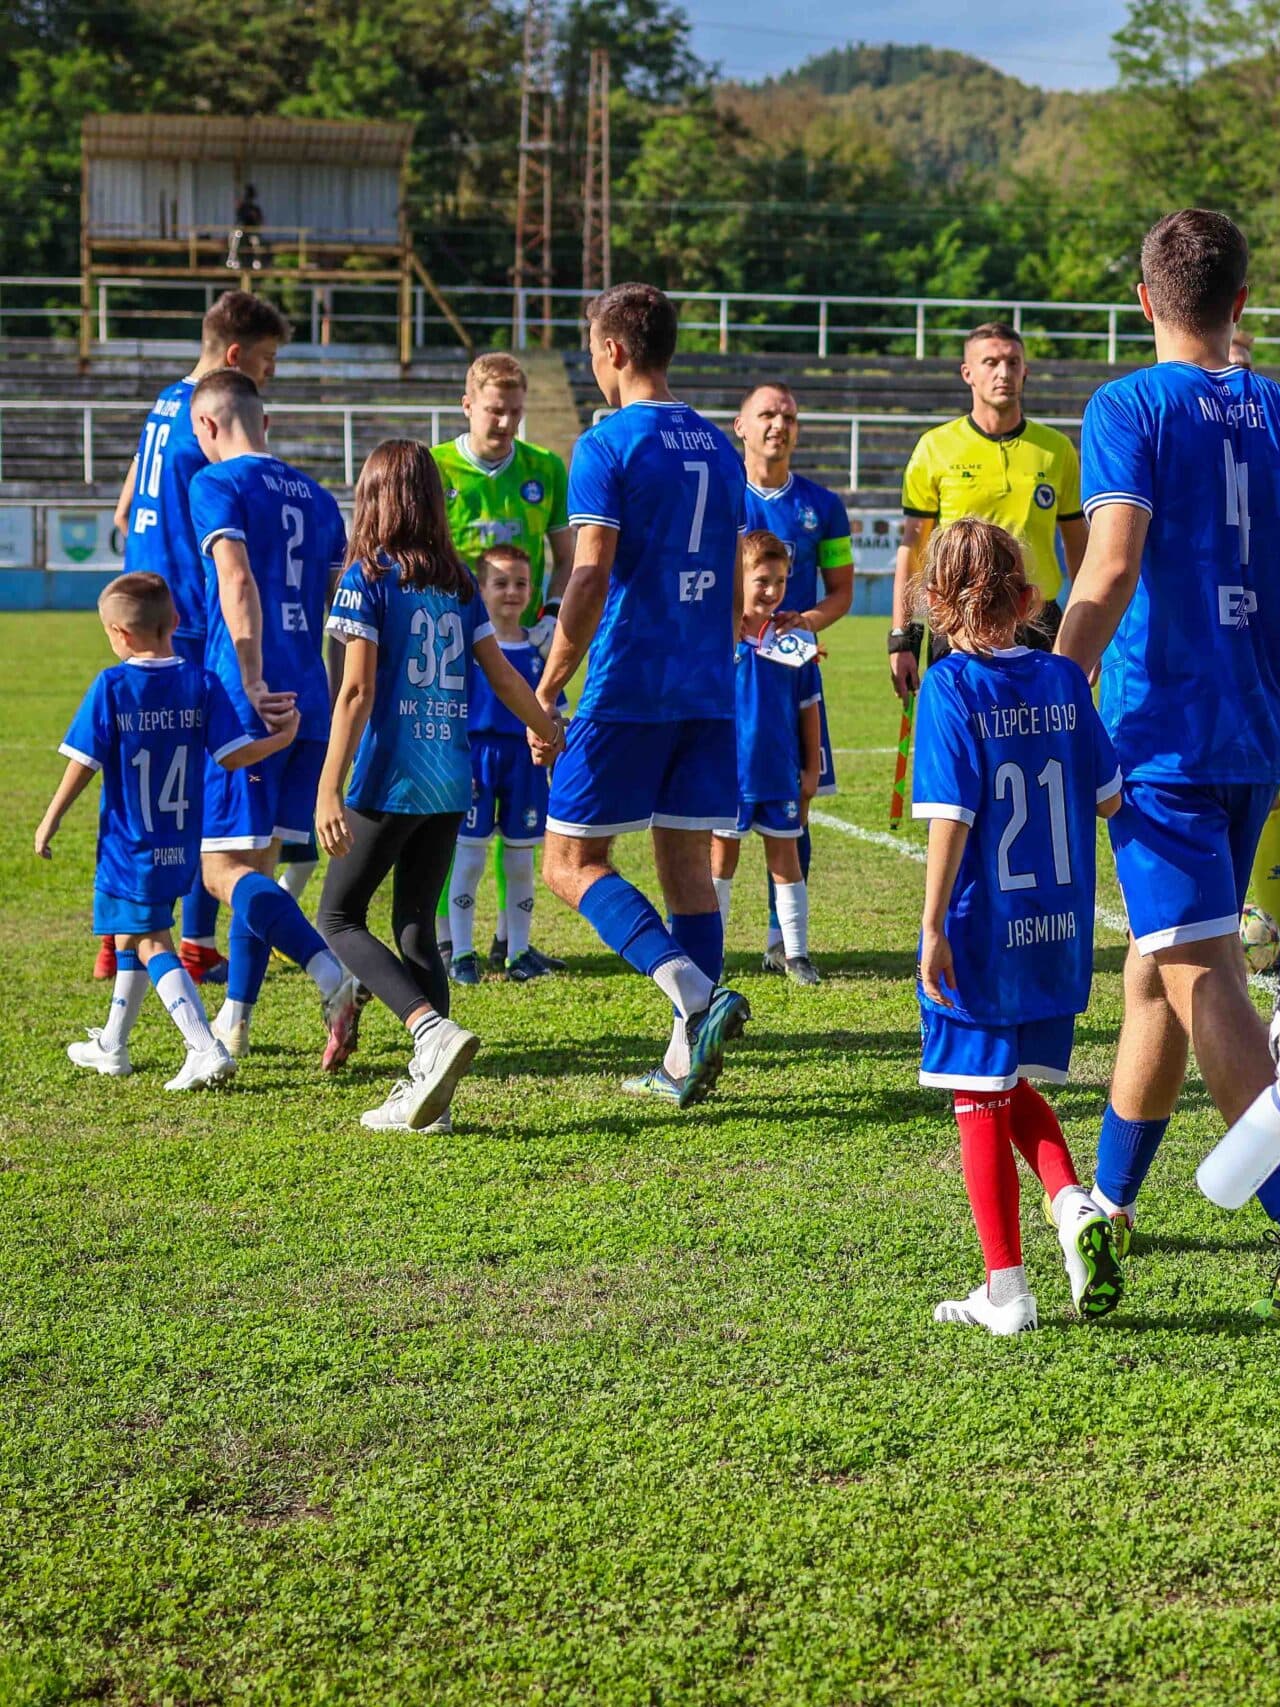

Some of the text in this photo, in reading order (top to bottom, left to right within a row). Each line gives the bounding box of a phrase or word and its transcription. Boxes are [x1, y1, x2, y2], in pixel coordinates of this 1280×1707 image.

[138, 422, 171, 498] 16
[660, 427, 719, 450] NK ŽEPČE
[683, 461, 709, 553] 7
[281, 503, 305, 590] 2
[679, 570, 716, 603] EP
[1218, 585, 1258, 630] EP
[407, 607, 465, 691] 32
[116, 713, 134, 732] NK
[136, 707, 176, 732] ŽEPČE
[399, 697, 469, 718] NK ŽEPČE
[990, 702, 1041, 738] ŽEPČE
[1044, 704, 1076, 732] 1919
[131, 745, 189, 833] 14
[995, 758, 1072, 891] 21
[1006, 911, 1076, 948] JASMINA
